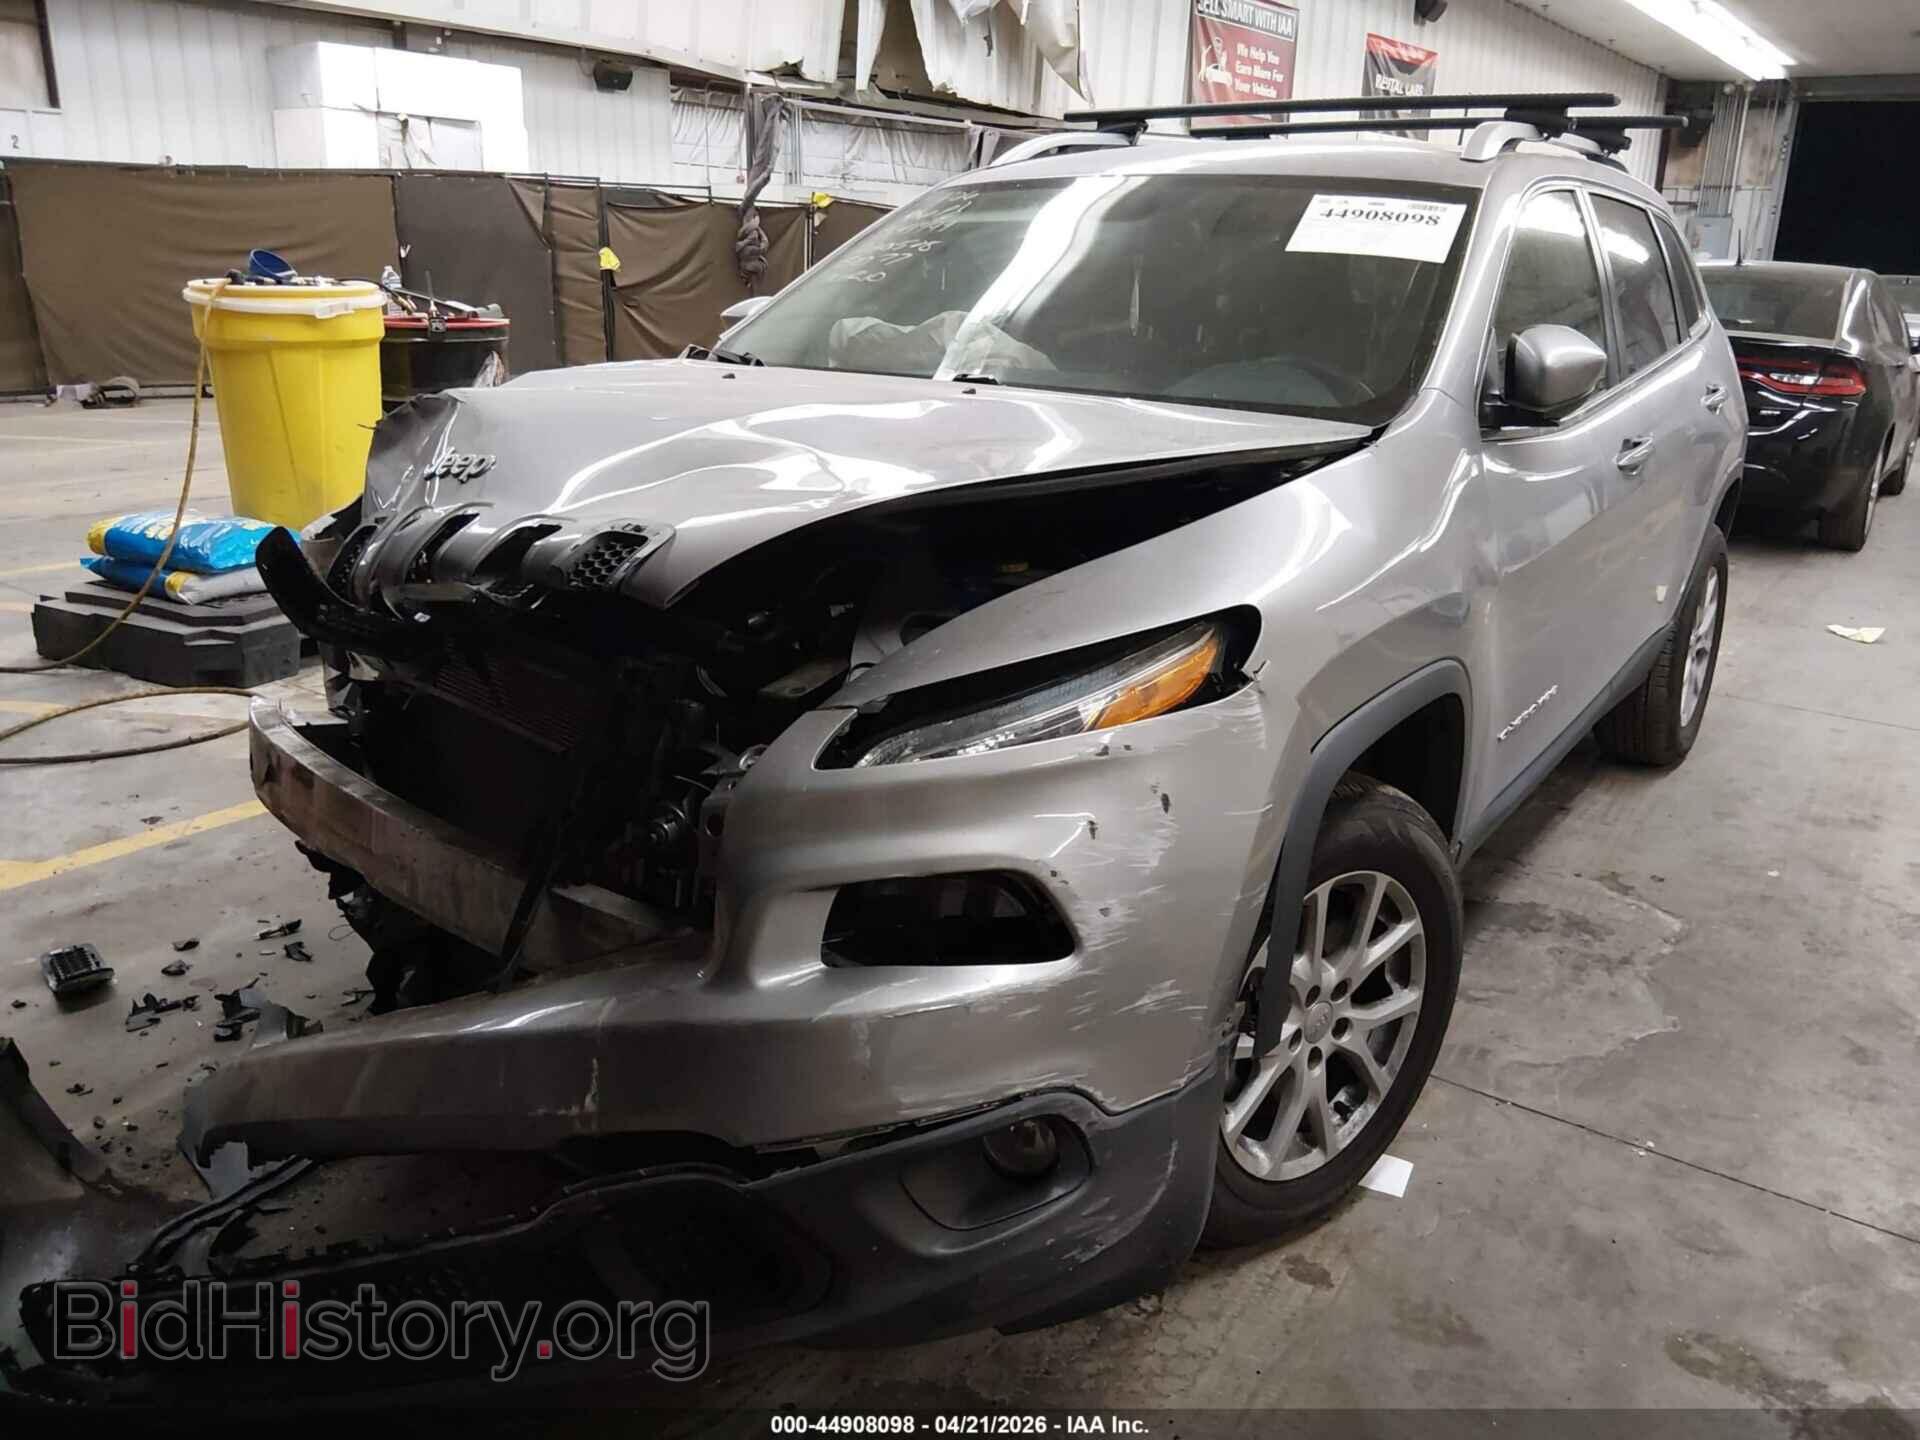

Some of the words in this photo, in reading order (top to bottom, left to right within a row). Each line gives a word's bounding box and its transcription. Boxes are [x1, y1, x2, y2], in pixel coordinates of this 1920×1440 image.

[1221, 1, 1255, 24] SMART
[1255, 8, 1278, 32] WITH
[1278, 15, 1293, 36] IAA
[1320, 208, 1440, 226] 44908098
[424, 446, 497, 483] Jeep
